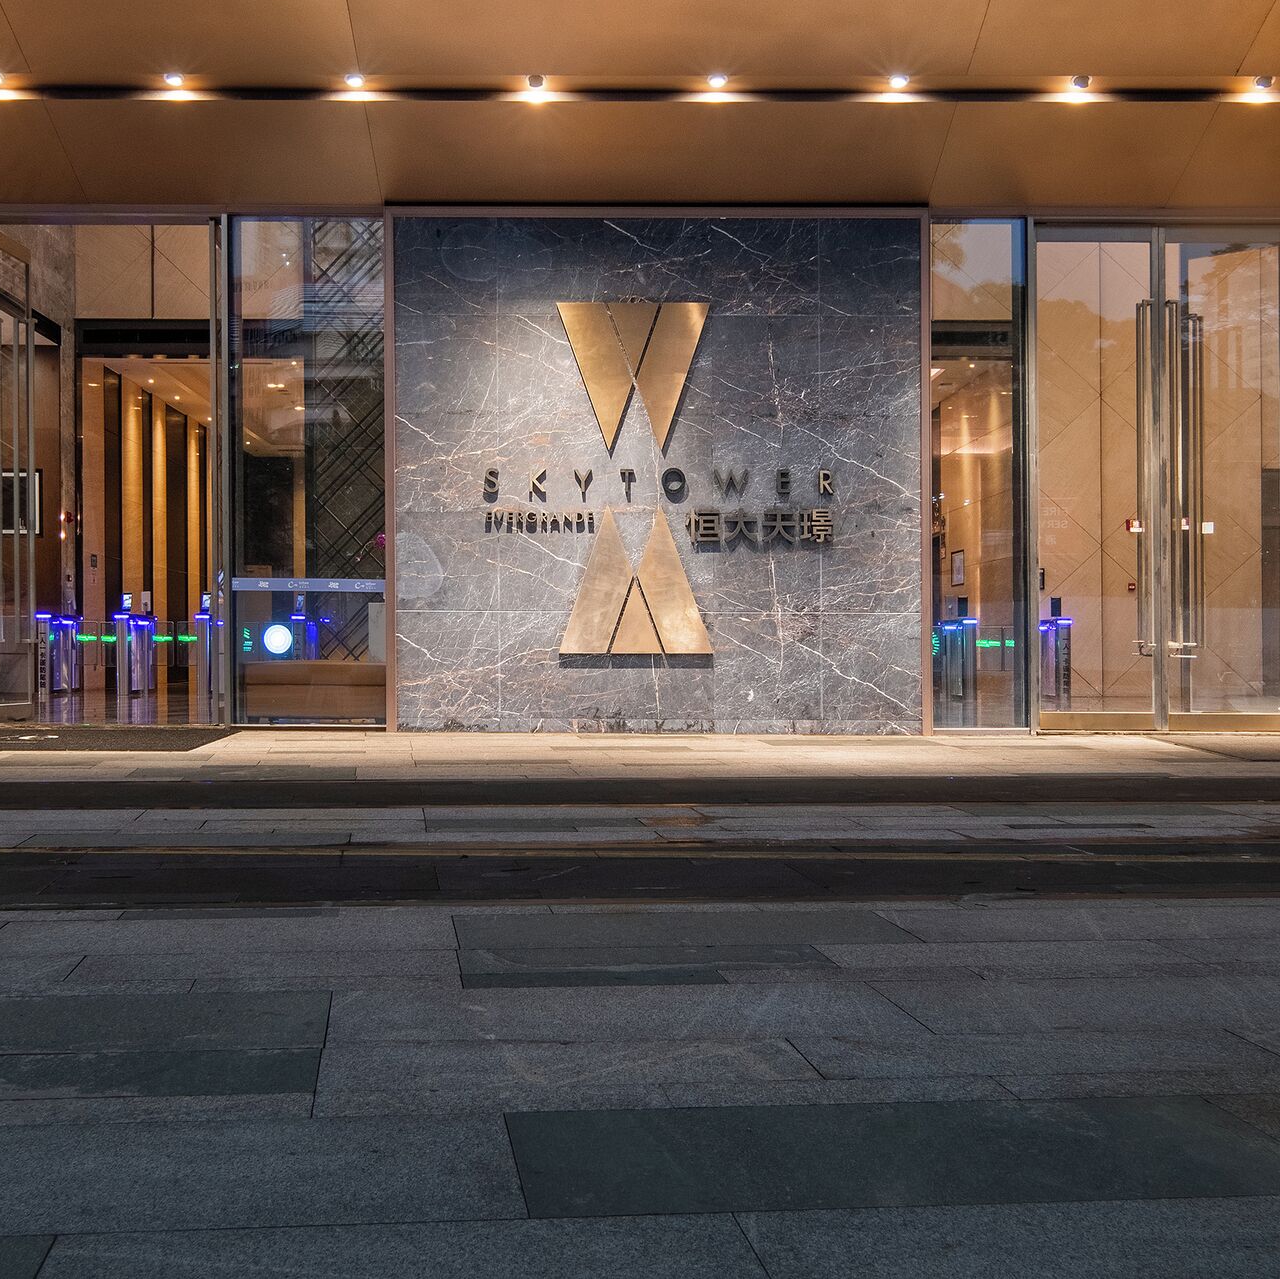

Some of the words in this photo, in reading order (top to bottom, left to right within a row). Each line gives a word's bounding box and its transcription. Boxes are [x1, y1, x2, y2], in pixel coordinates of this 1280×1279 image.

[483, 467, 834, 498] SKYTOWER
[485, 511, 595, 526] EVERGRANDE
[685, 507, 834, 544] 恒大天璟
